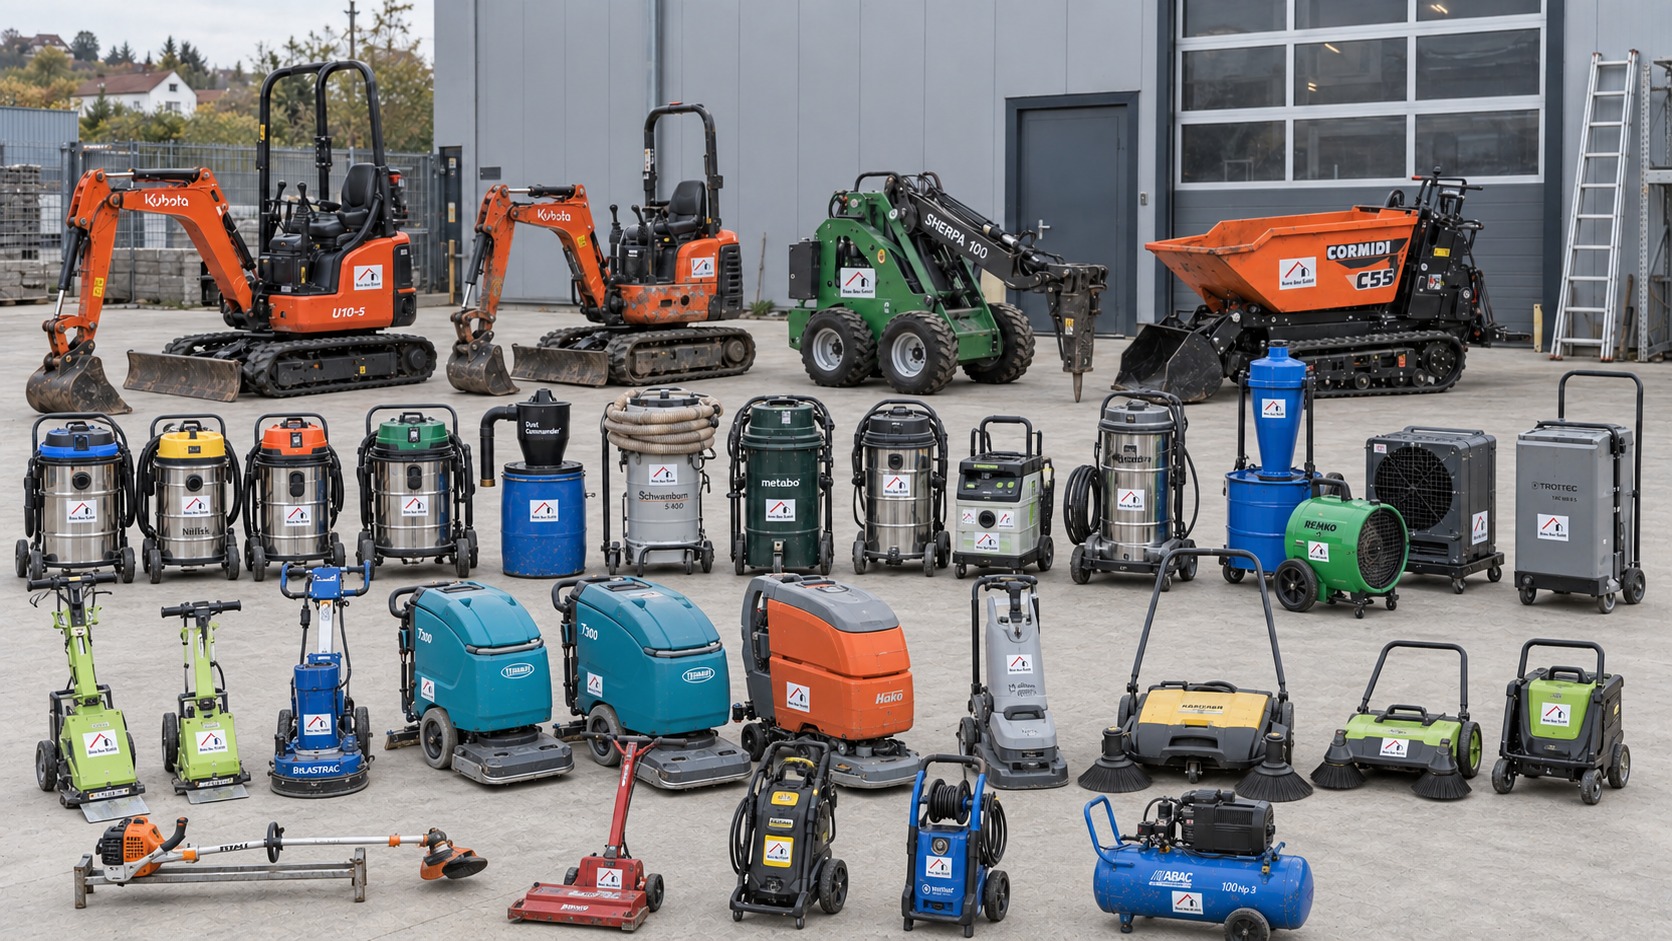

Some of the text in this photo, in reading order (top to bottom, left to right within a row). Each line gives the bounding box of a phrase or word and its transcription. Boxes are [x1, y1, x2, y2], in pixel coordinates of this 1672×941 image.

[144, 193, 189, 207] Kubota
[537, 208, 571, 222] Kubota
[924, 213, 988, 259] SHERPA 100
[1326, 240, 1391, 259] CORMIDI
[1356, 269, 1394, 290] C55
[332, 306, 365, 319] U10-5
[761, 478, 800, 487] metabo
[1304, 520, 1337, 532] REMKO
[580, 622, 598, 641] T300
[875, 691, 904, 705] Hako
[1163, 870, 1194, 883] ABAC
